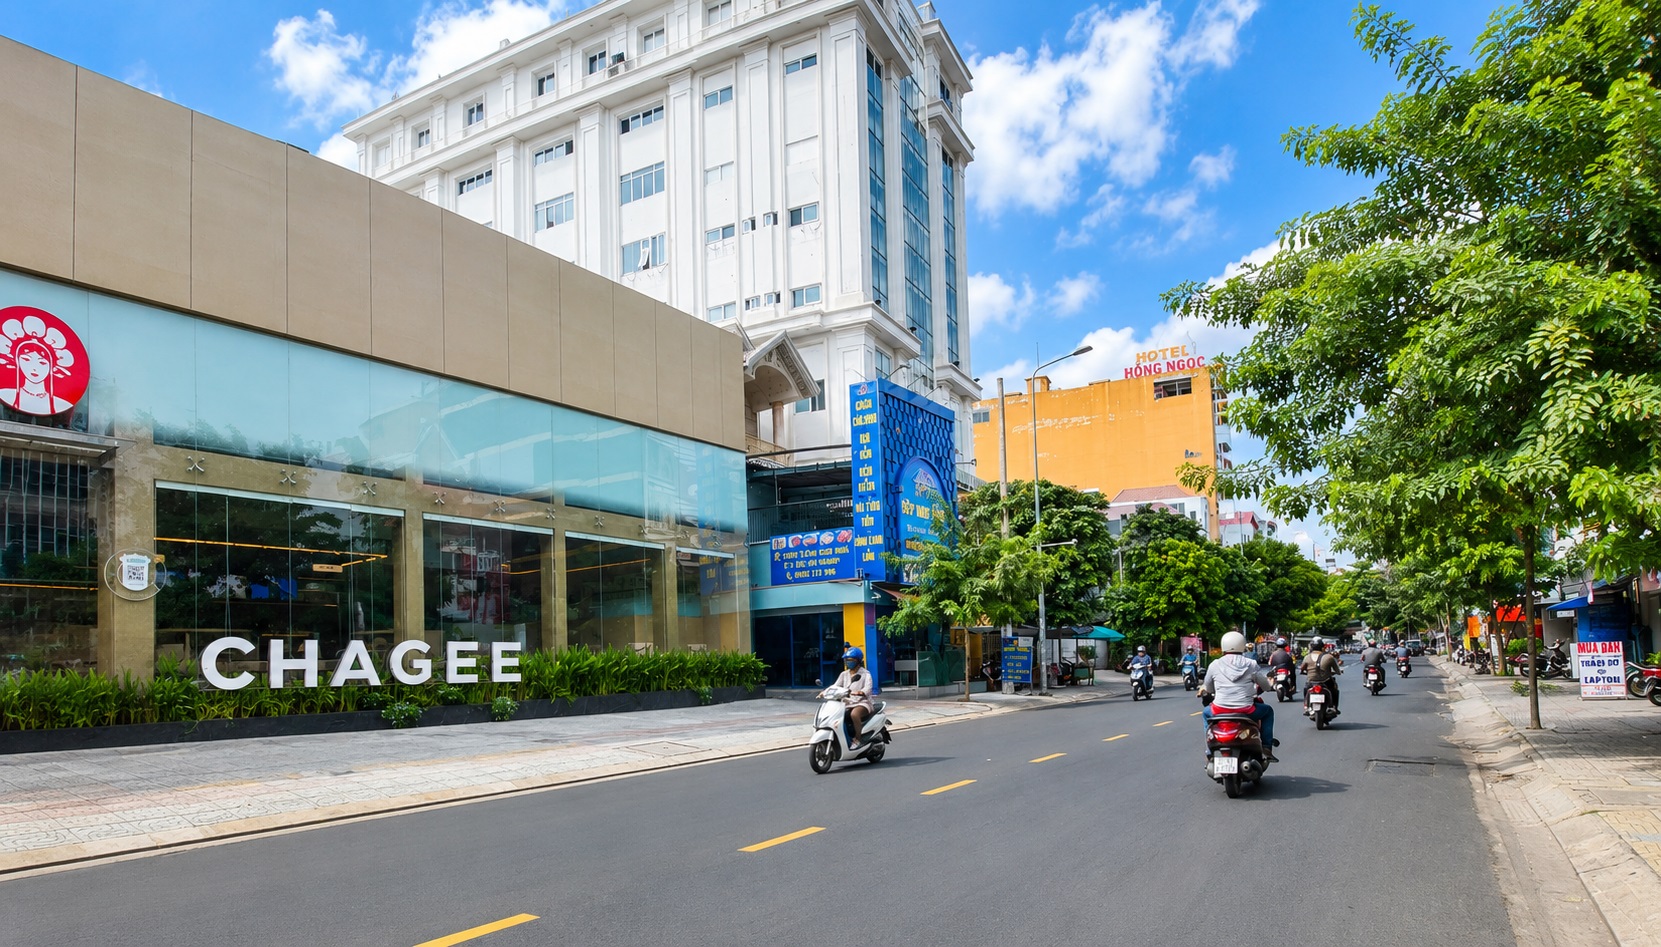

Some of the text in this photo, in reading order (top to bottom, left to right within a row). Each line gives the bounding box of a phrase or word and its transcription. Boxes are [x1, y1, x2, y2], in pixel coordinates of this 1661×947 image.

[1136, 345, 1189, 363] HOTEL
[1577, 642, 1599, 654] MUA
[201, 636, 522, 691] CHAGEE
